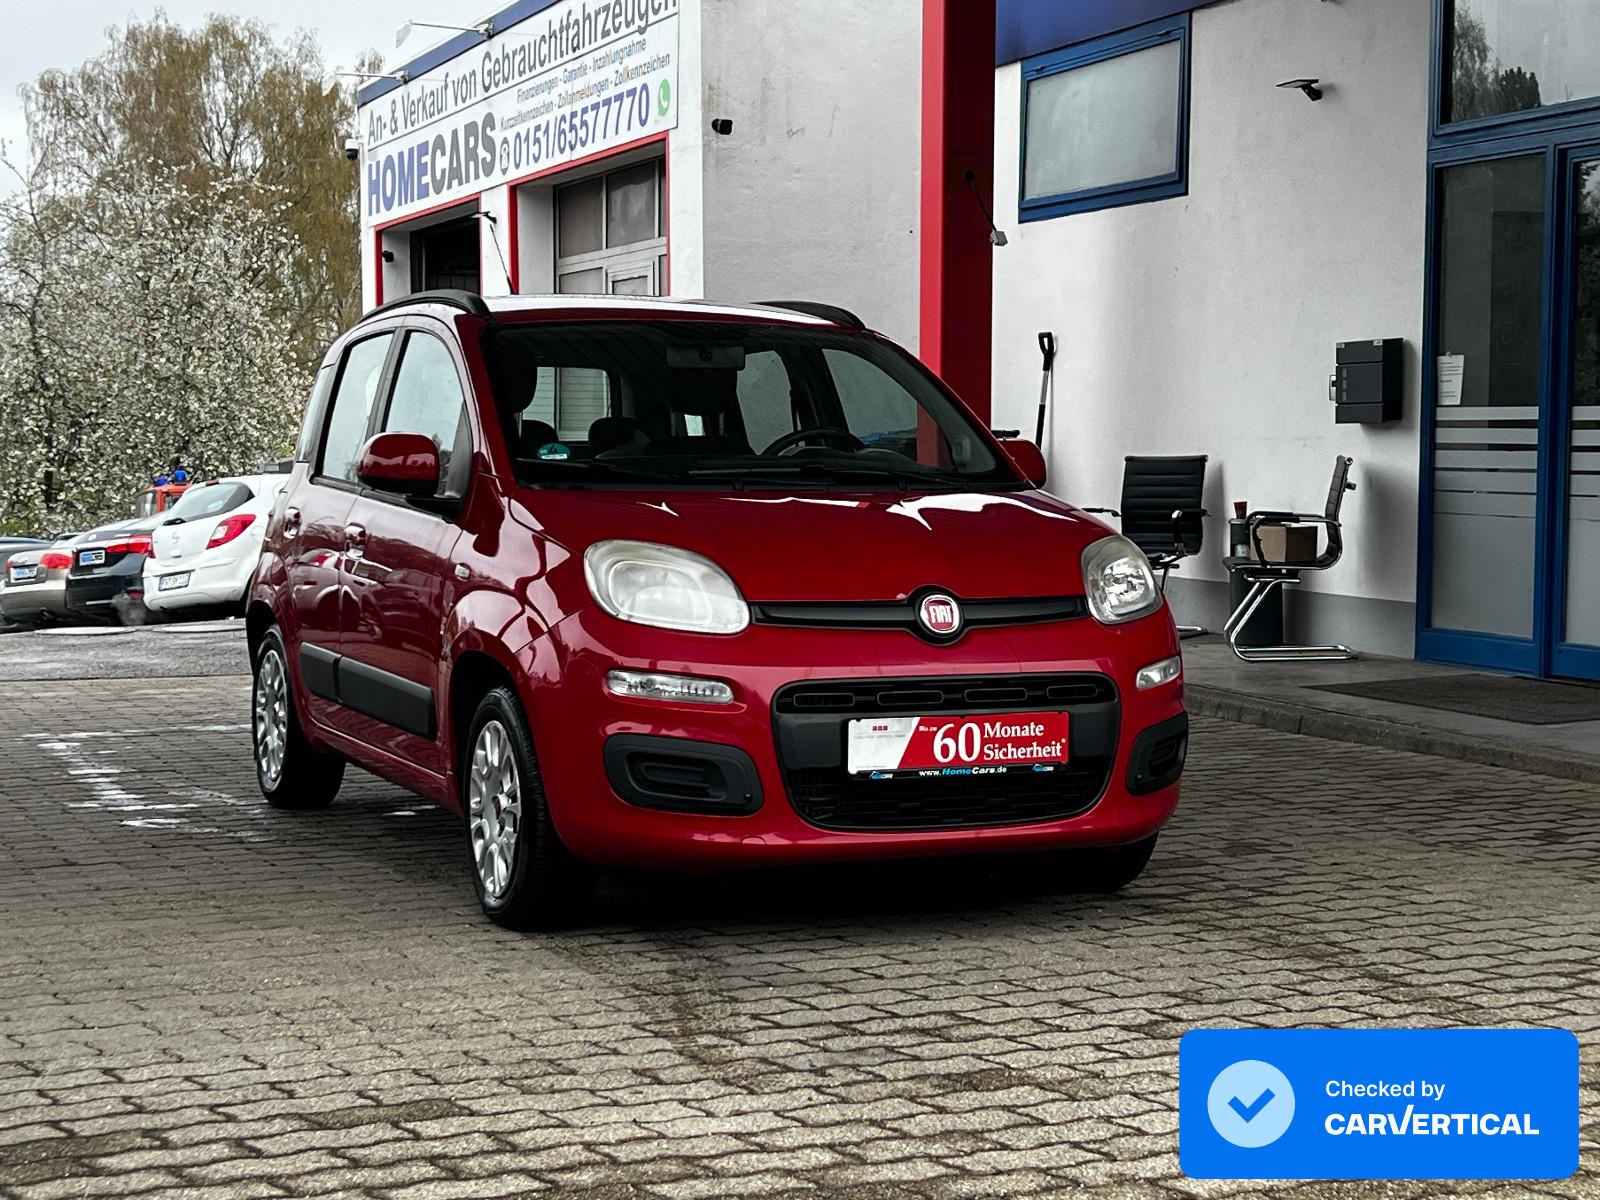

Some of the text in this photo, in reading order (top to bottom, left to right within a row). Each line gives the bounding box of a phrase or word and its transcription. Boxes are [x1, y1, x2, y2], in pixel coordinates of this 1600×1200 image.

[517, 76, 559, 104] Finanzierungen
[563, 61, 588, 84] Garantie
[557, 78, 610, 109] Zollanmeldungen
[614, 53, 670, 87] Zollkennzeichen
[368, 110, 387, 146] An-
[390, 98, 399, 136] &
[401, 72, 449, 130] Verkauf
[453, 69, 477, 107] von
[513, 82, 650, 170] 0151/65577770
[368, 111, 497, 216] HOMECARS
[929, 605, 953, 623] FIAT
[933, 722, 982, 763] 60
[983, 721, 1045, 739] Monate
[919, 765, 1007, 777] www.HomeCars.de
